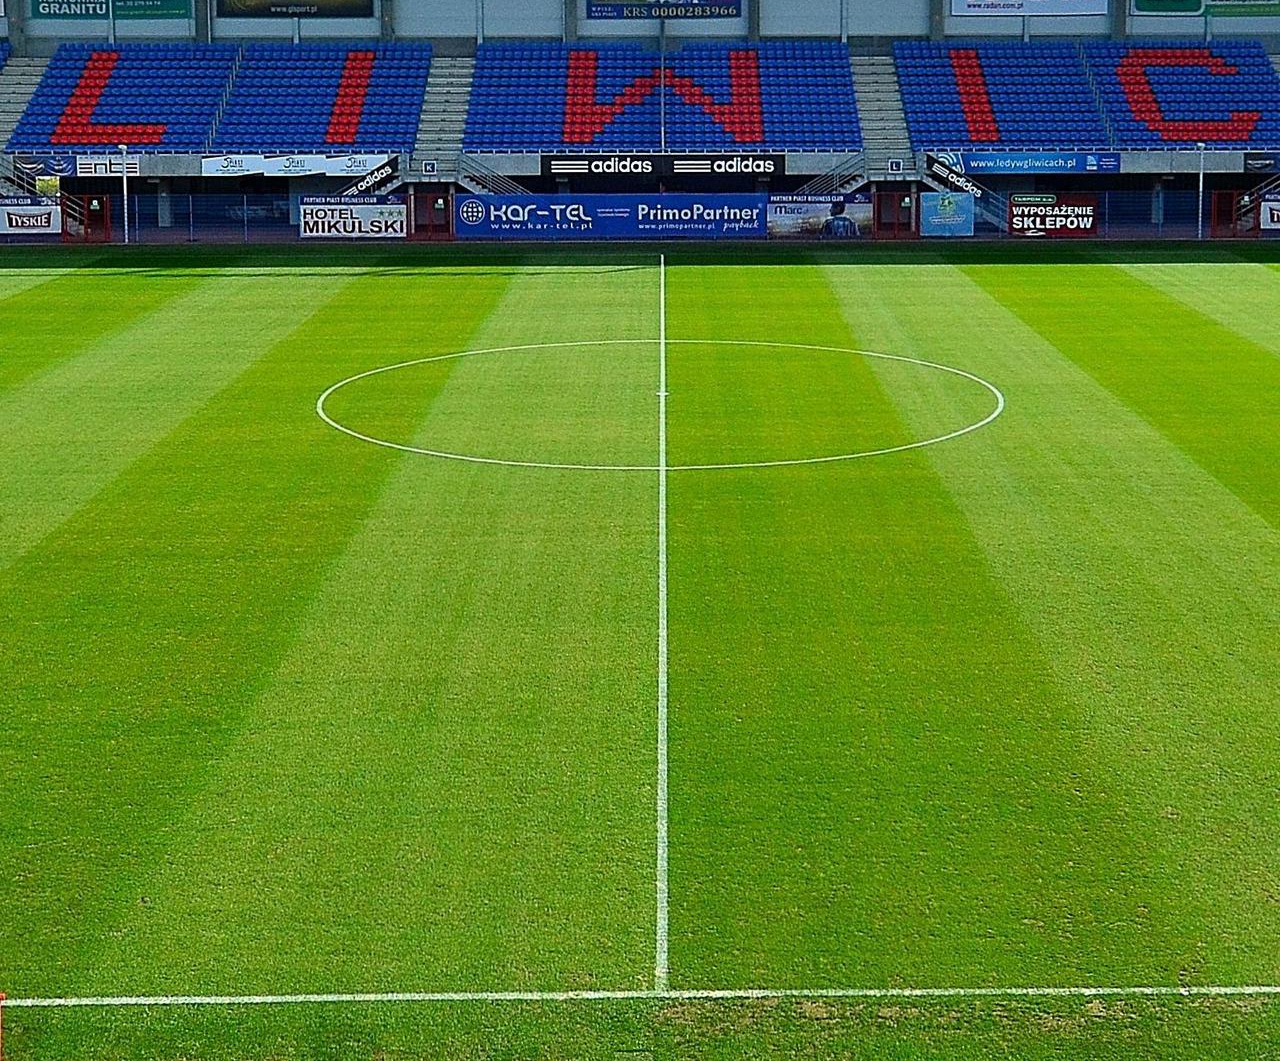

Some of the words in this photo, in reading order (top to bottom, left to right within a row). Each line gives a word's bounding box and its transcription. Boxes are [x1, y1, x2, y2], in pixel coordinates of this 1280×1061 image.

[39, 4, 106, 15] GRANITU
[623, 7, 648, 17] KRS
[652, 6, 737, 17] 0000283966
[591, 157, 653, 173] adidas
[713, 157, 775, 173] adidas
[970, 158, 1076, 169] www.ledywgliwicach.pl
[358, 165, 393, 191] adidas
[947, 172, 982, 198] adidas
[303, 208, 360, 220] HOTEL
[638, 203, 760, 221] PrimoPartner
[1012, 205, 1093, 216] WYPOSAŻENIE
[10, 215, 49, 227] TYSKIE
[303, 219, 404, 234] MIKULSKI
[490, 222, 593, 230] www.kar-tel.pl
[638, 222, 715, 230] www.primopartner.pl
[723, 219, 760, 232] payback
[1012, 214, 1093, 229] SKLEPÓW
